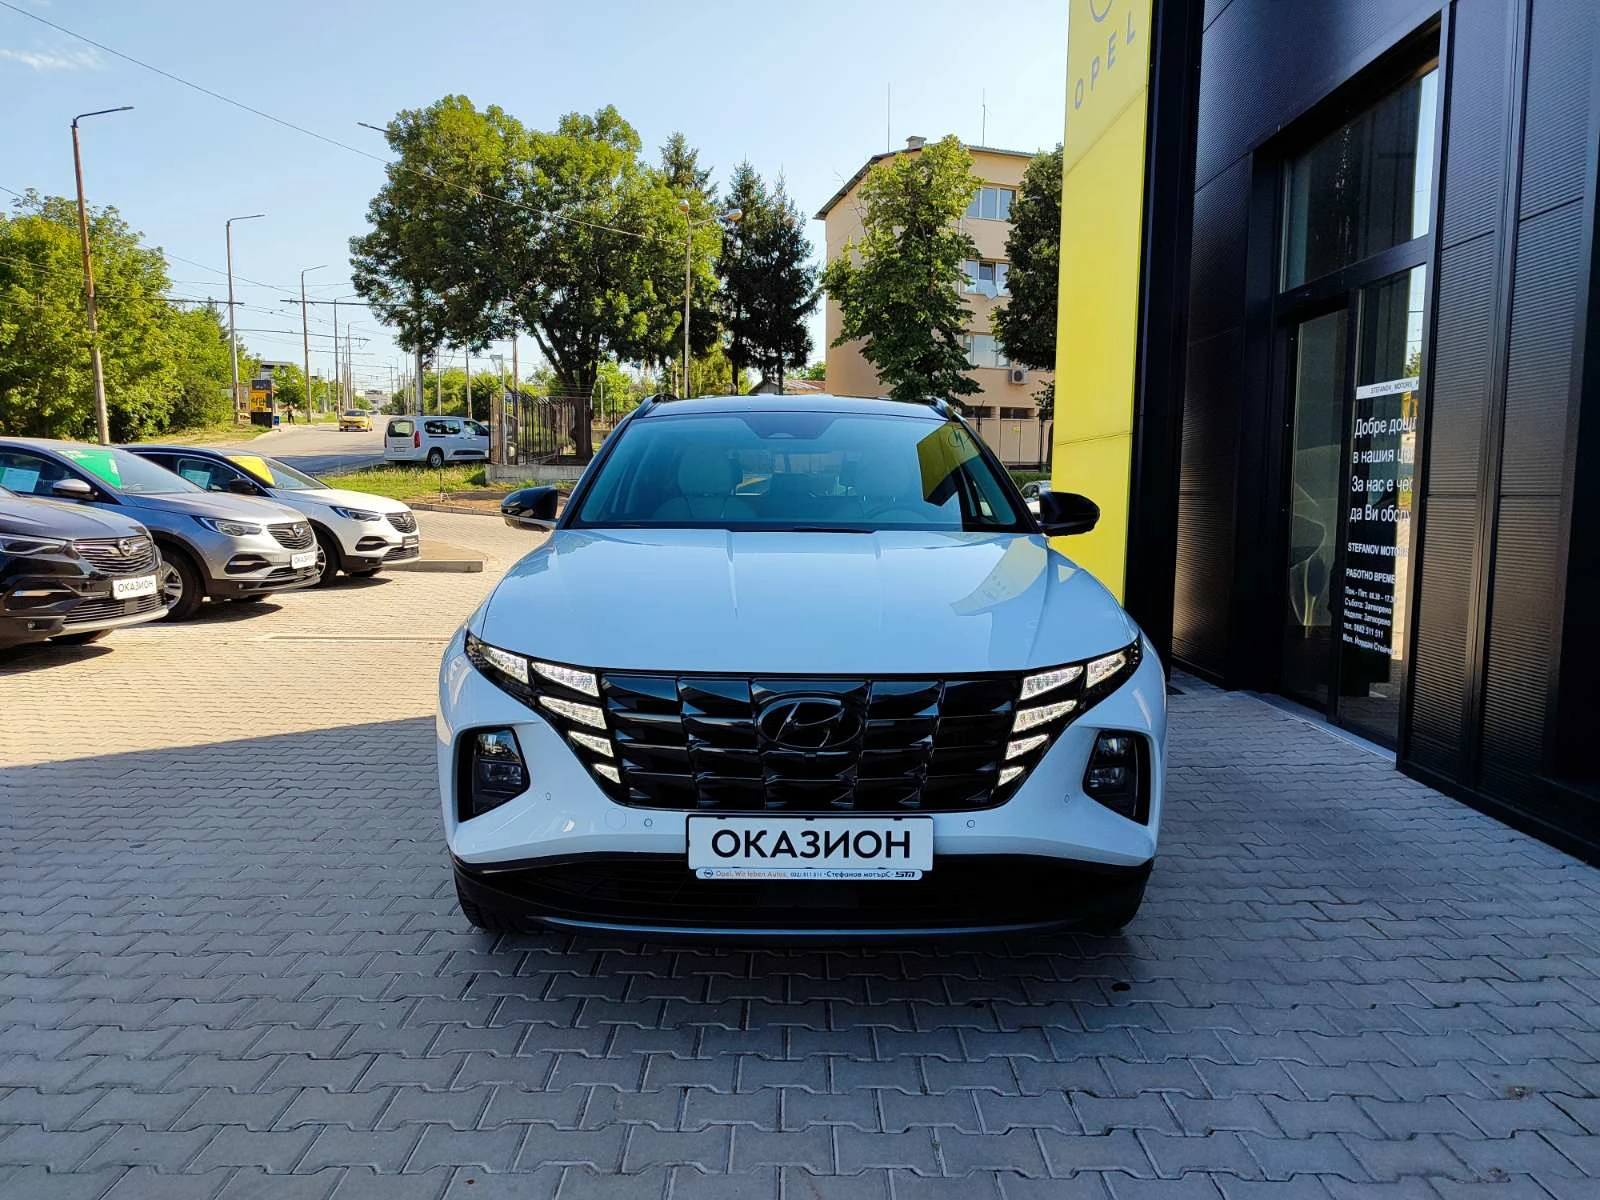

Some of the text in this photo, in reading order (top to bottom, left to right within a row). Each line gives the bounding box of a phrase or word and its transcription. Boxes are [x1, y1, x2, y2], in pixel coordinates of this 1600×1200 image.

[1075, 10, 1136, 110] OPEL
[1354, 417, 1386, 439] Добре
[1353, 452, 1359, 464] в
[1361, 449, 1394, 464] нашия
[1351, 475, 1364, 493] За
[1366, 480, 1385, 493] нас
[1386, 479, 1394, 492] е
[1349, 507, 1362, 523] да
[1365, 504, 1378, 521] Ви
[1347, 542, 1380, 556] STEFANOV
[1345, 568, 1374, 581] РАБОТНО
[117, 579, 154, 593] ОКАЗИОН
[1364, 601, 1392, 615] Затворено
[711, 829, 911, 859] ОКАЗИОН
